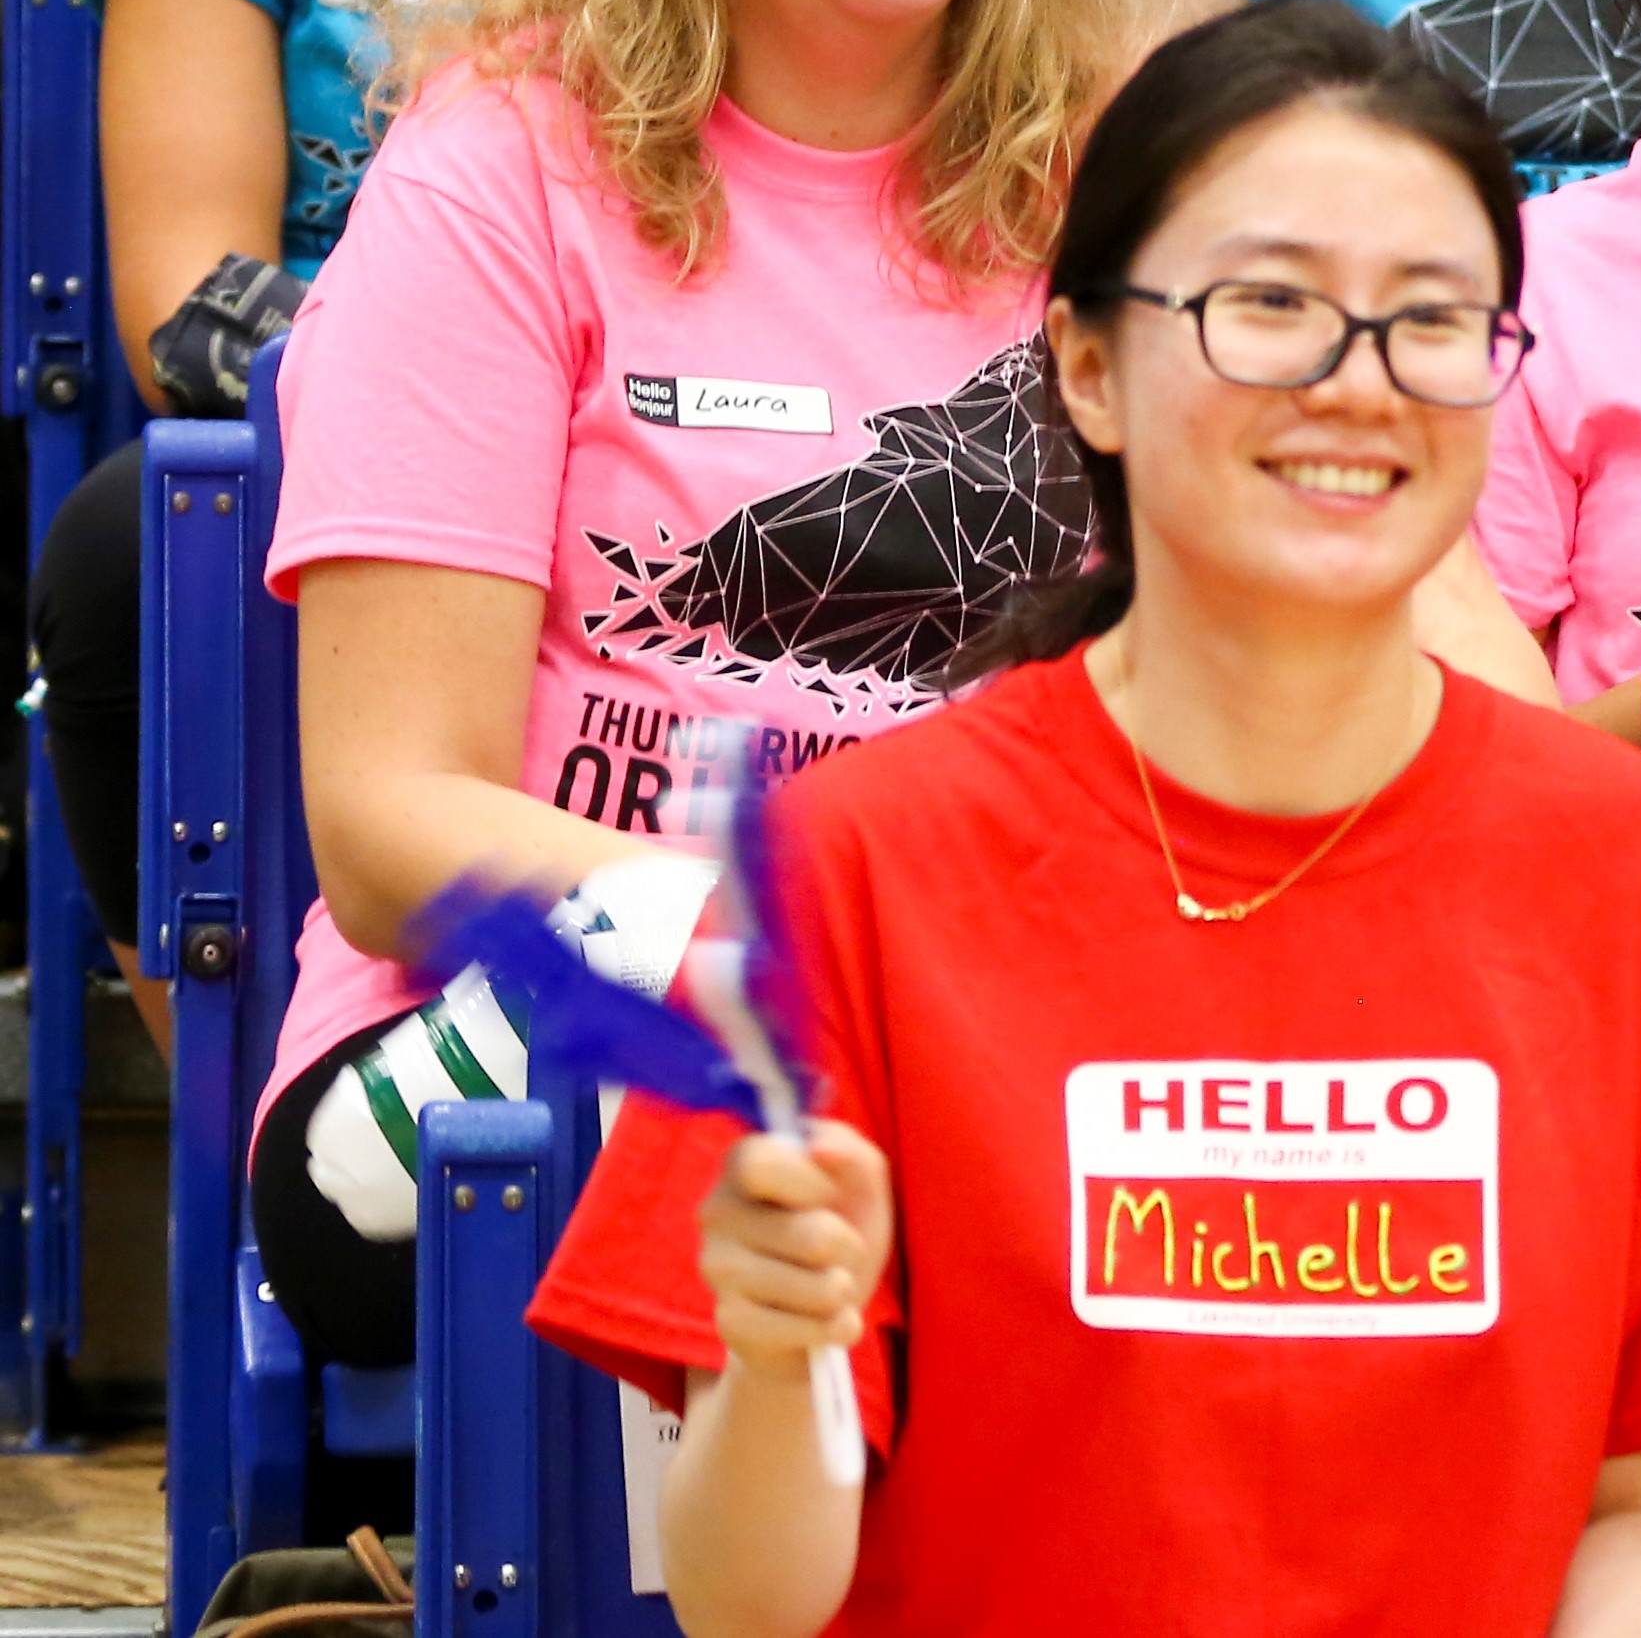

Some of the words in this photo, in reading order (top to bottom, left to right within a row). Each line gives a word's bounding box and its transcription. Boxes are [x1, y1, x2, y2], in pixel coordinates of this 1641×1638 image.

[629, 378, 671, 400] Hello
[695, 388, 788, 415] Laura
[629, 393, 675, 417] Bonjour
[1123, 1078, 1448, 1133] HELLO
[1203, 1145, 1242, 1169] my
[1253, 1146, 1332, 1166] name
[1342, 1144, 1366, 1165] is
[1104, 1186, 1470, 1298] Michelle
